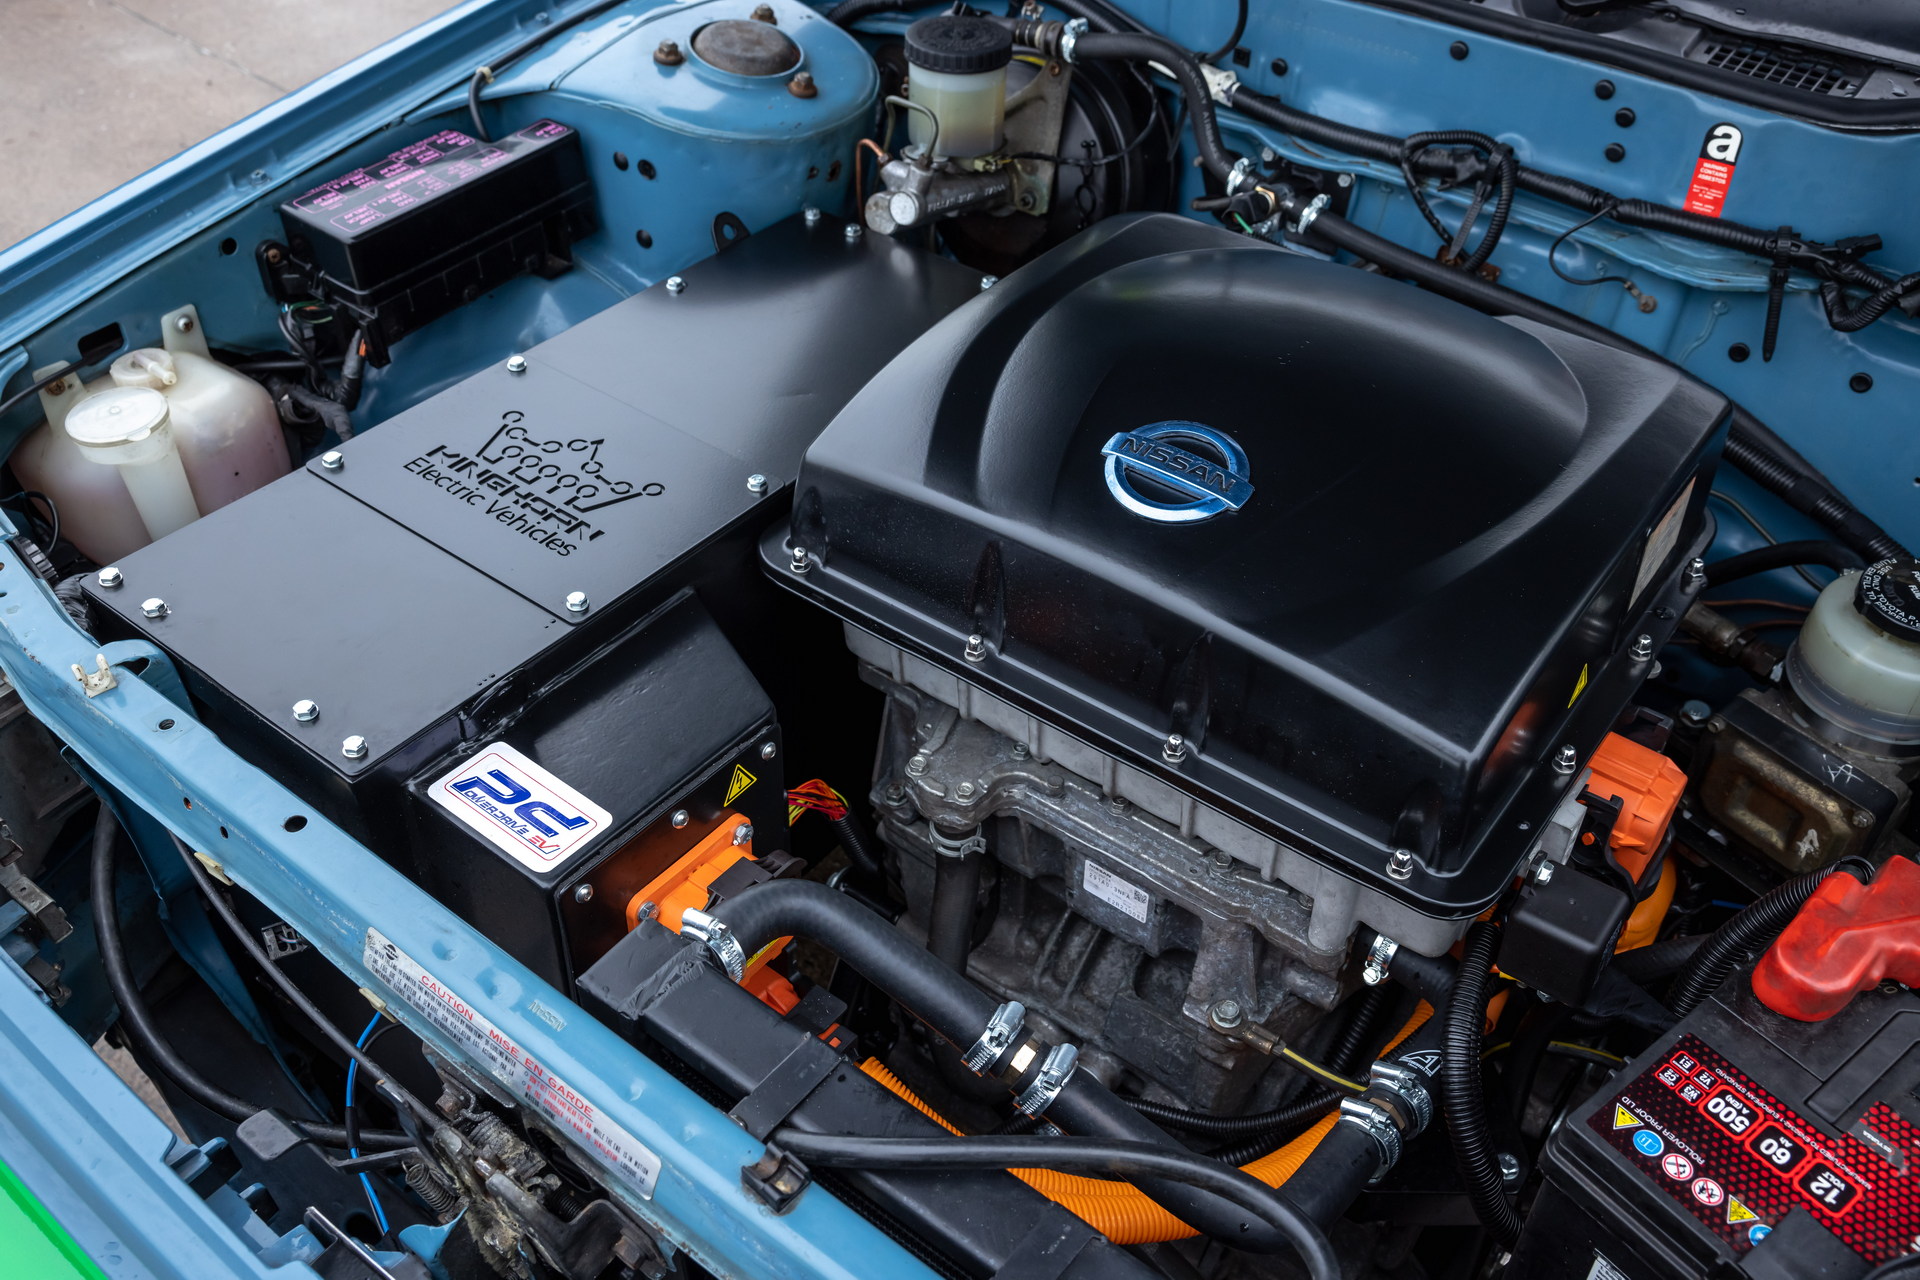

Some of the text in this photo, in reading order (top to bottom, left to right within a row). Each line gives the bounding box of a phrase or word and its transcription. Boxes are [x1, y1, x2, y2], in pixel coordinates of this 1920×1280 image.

[1707, 125, 1742, 162] a
[1118, 437, 1236, 493] NISSAN
[403, 456, 578, 557] Electric Vehicles
[1863, 575, 1872, 589] FILL
[1867, 591, 1877, 600] TO
[1877, 593, 1905, 617] TOYOTA
[528, 835, 560, 849] EV
[1089, 863, 1112, 878] NISSAN
[420, 973, 474, 1022] CAUTION
[490, 1029, 593, 1118] MISE EN GARDE
[1679, 1058, 1692, 1069] E1
[1698, 1072, 1712, 1085] V2
[1712, 1067, 1749, 1093] STANDARD
[1684, 1086, 1698, 1100] W3
[1723, 1093, 1750, 1115] A (EN)
[1743, 1091, 1782, 1119] EUROPEAN
[1704, 1093, 1753, 1134] 500
[1620, 1094, 1705, 1165] ROLLOVER PROOF LID
[1776, 1135, 1793, 1148] Ah
[1755, 1135, 1795, 1166] 60
[1808, 1139, 1822, 1150] TO
[1803, 1174, 1848, 1205] 12
[1820, 1170, 1849, 1190] VOLT
